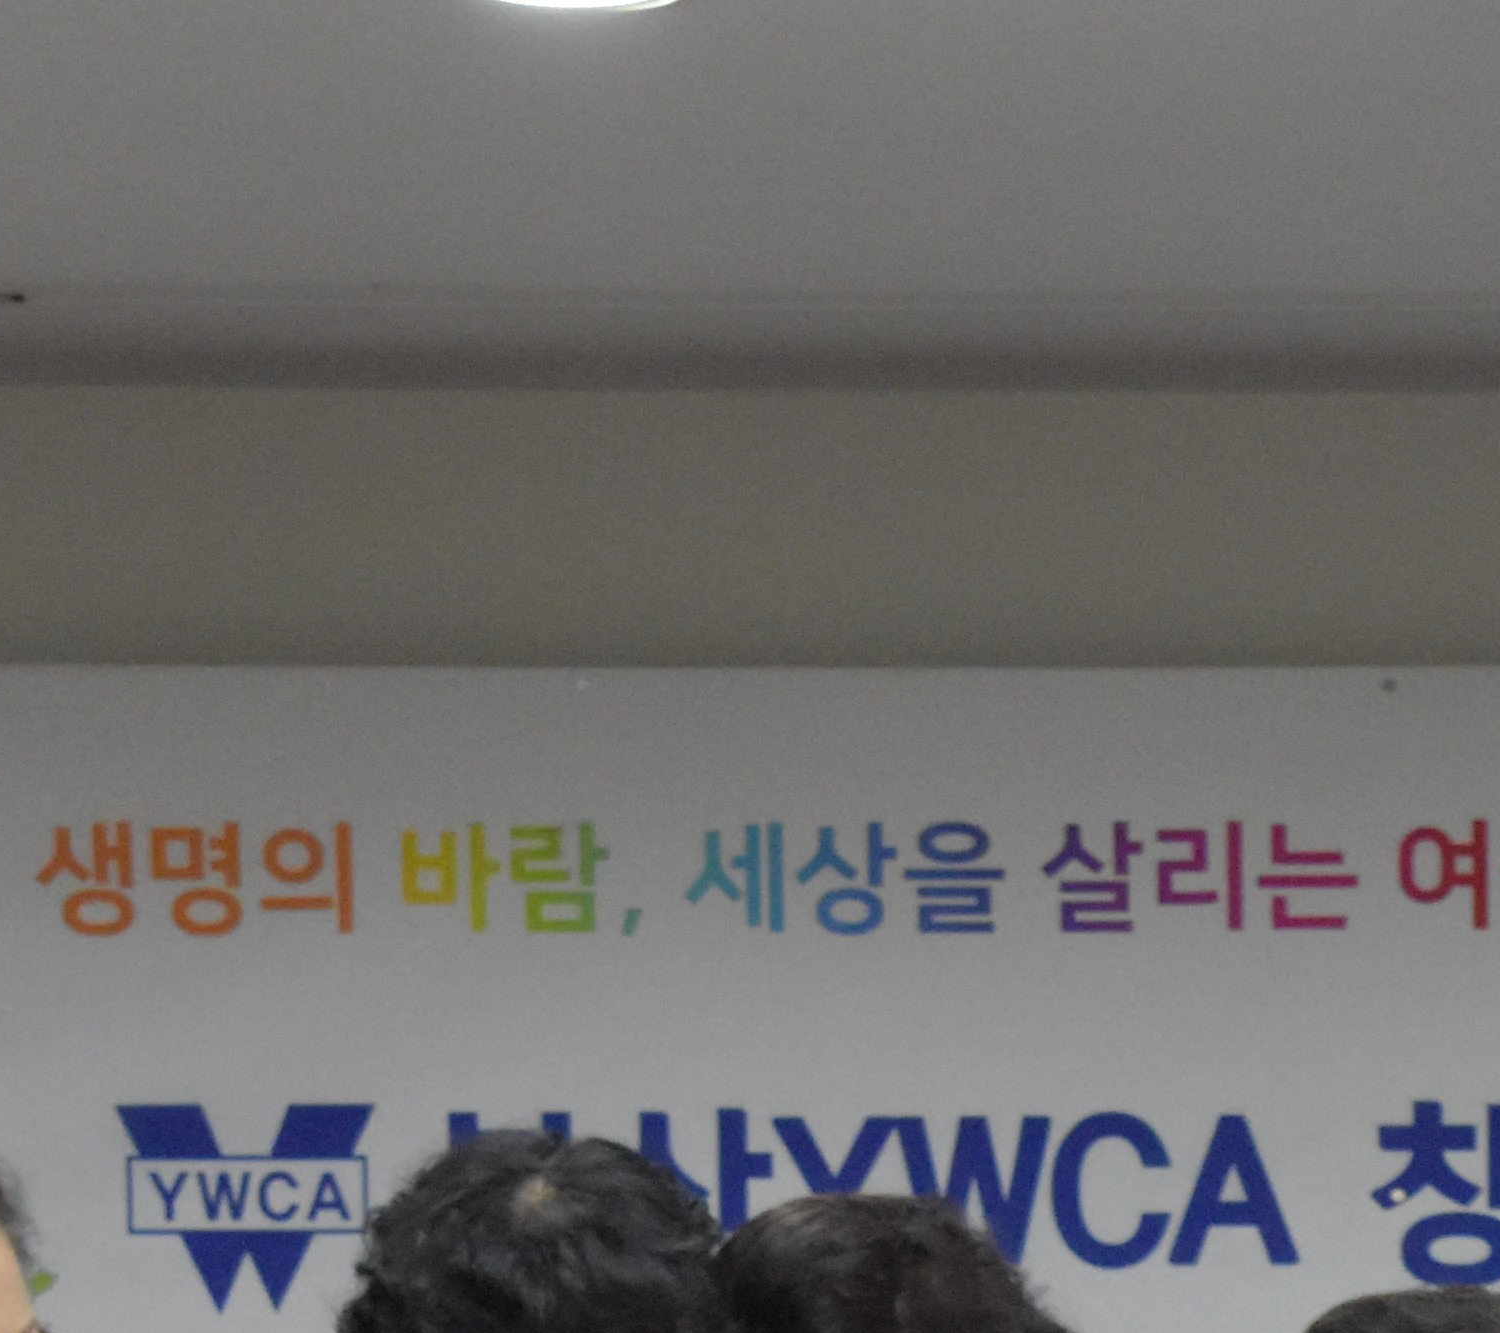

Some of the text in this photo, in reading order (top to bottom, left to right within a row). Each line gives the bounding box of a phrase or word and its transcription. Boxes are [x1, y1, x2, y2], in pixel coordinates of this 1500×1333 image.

[35, 821, 354, 936] 생명의
[401, 821, 642, 936] 바람,
[686, 821, 1005, 936] 세상을
[1042, 820, 1359, 933] 살리는
[150, 1171, 351, 1222] YWCA
[448, 1108, 1301, 1271] YWCA
